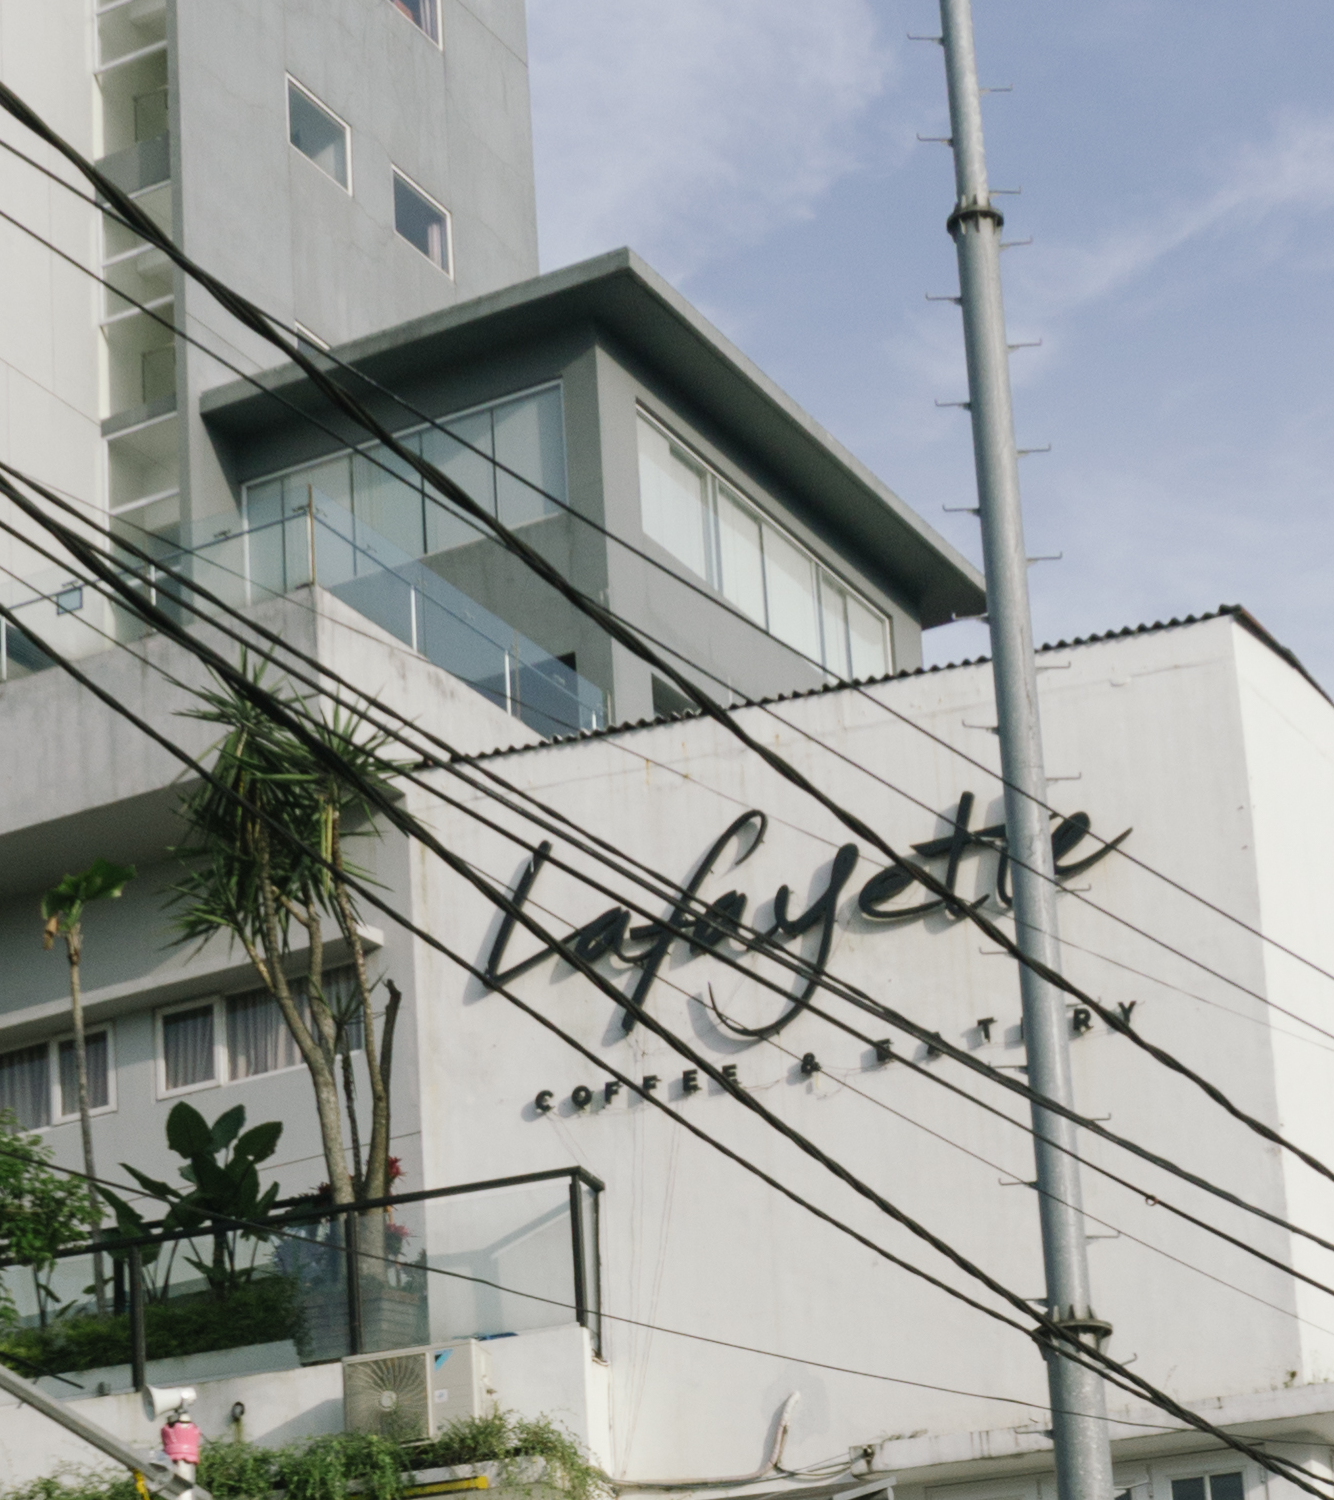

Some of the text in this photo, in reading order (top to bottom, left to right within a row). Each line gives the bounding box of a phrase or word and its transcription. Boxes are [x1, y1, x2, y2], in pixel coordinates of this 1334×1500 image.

[534, 1000, 1138, 1114] COFFEE & EATRY
